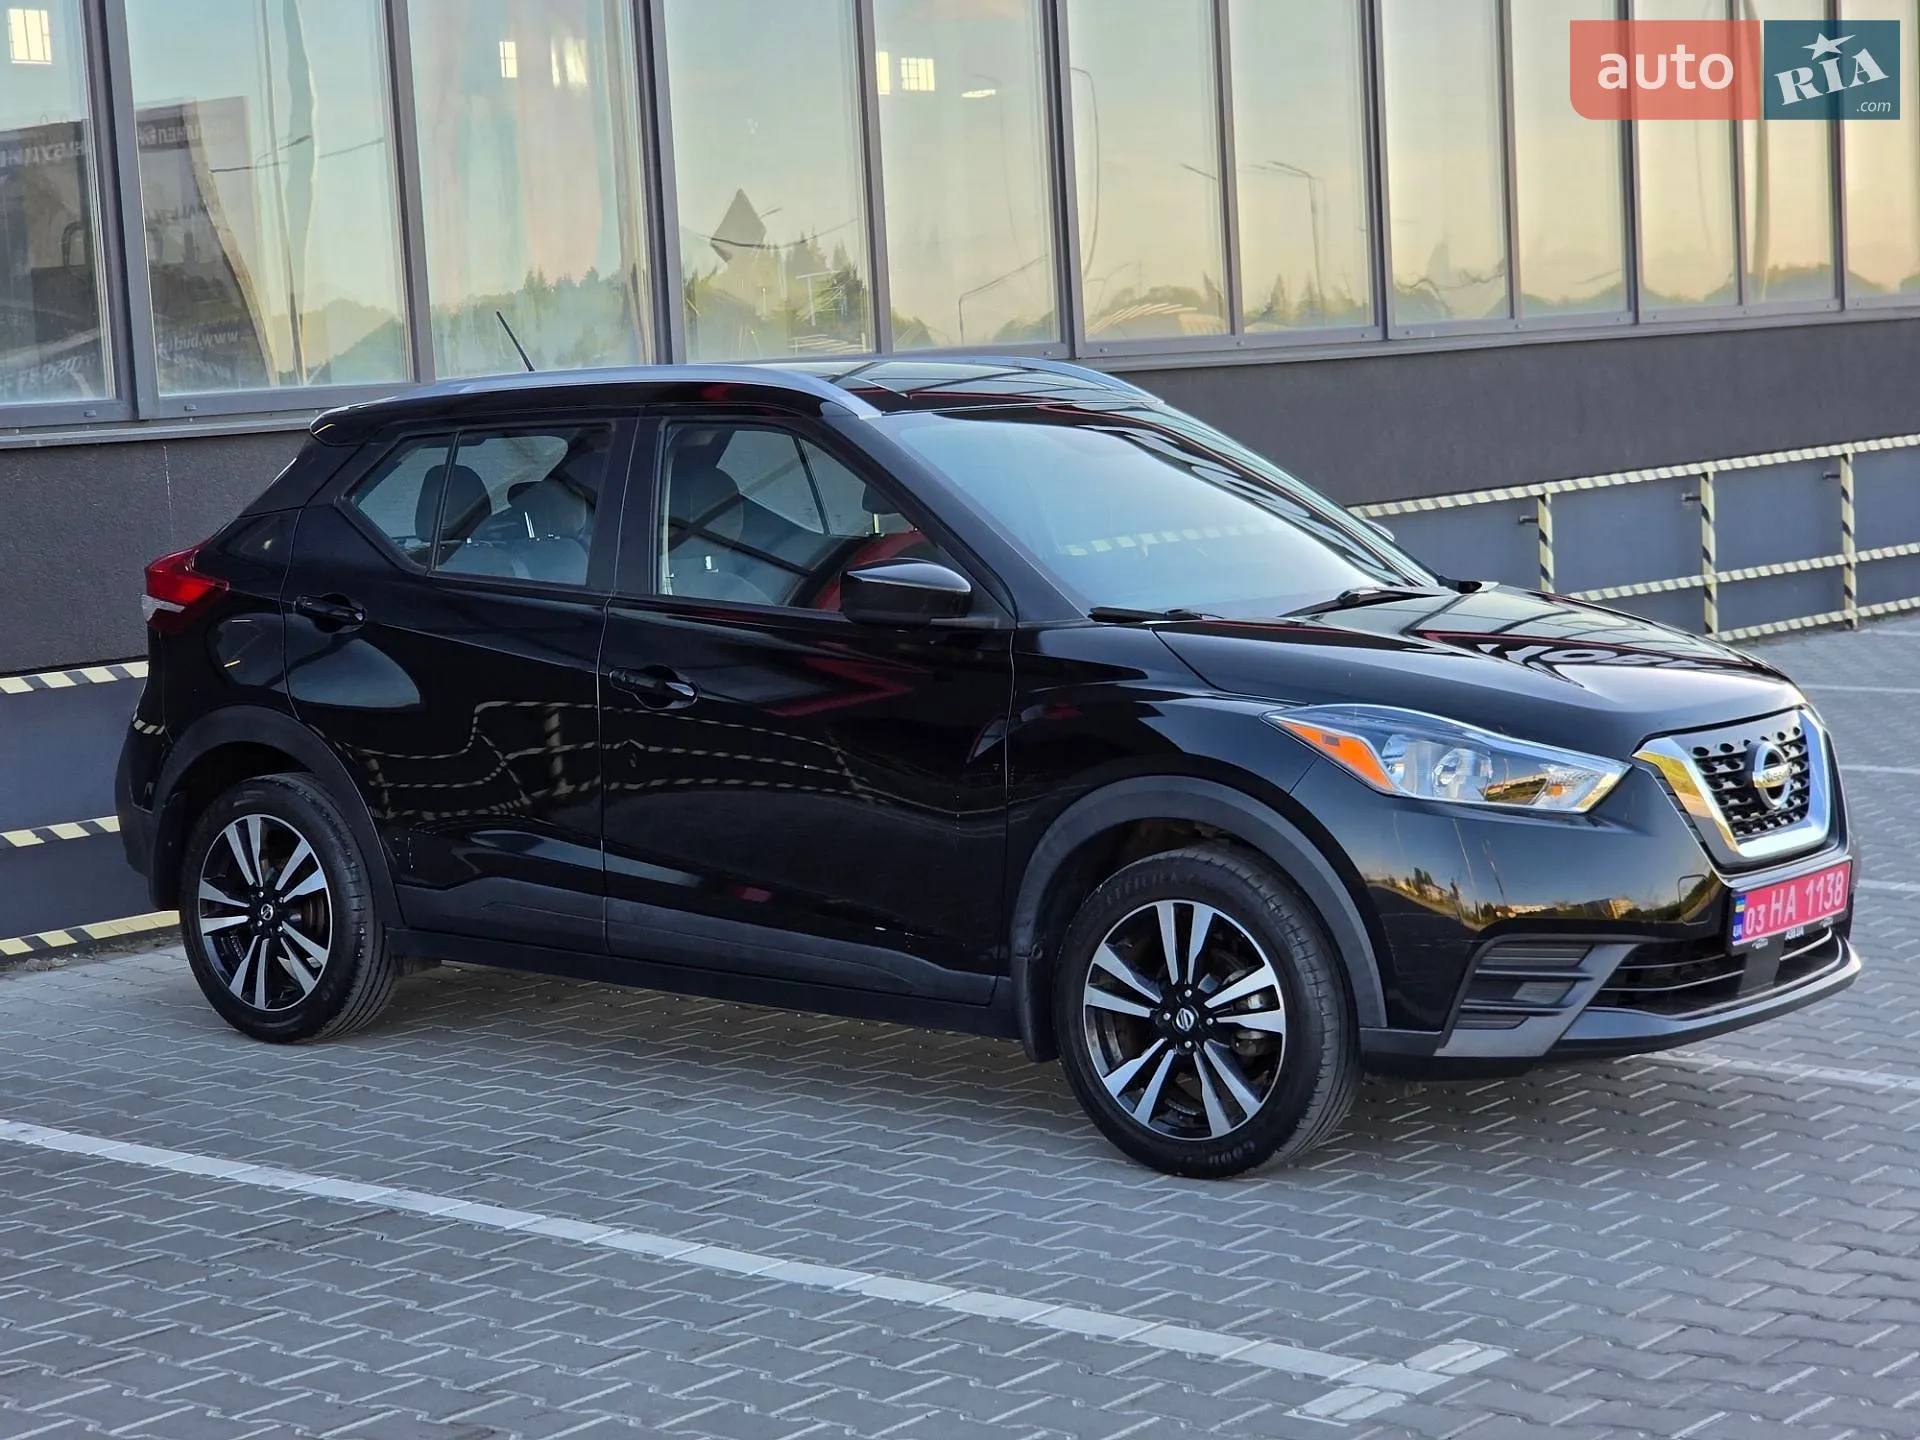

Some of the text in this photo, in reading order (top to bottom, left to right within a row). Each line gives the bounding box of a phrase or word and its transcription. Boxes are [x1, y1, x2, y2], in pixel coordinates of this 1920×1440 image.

[1745, 870, 1844, 935] 03 HA 1138
